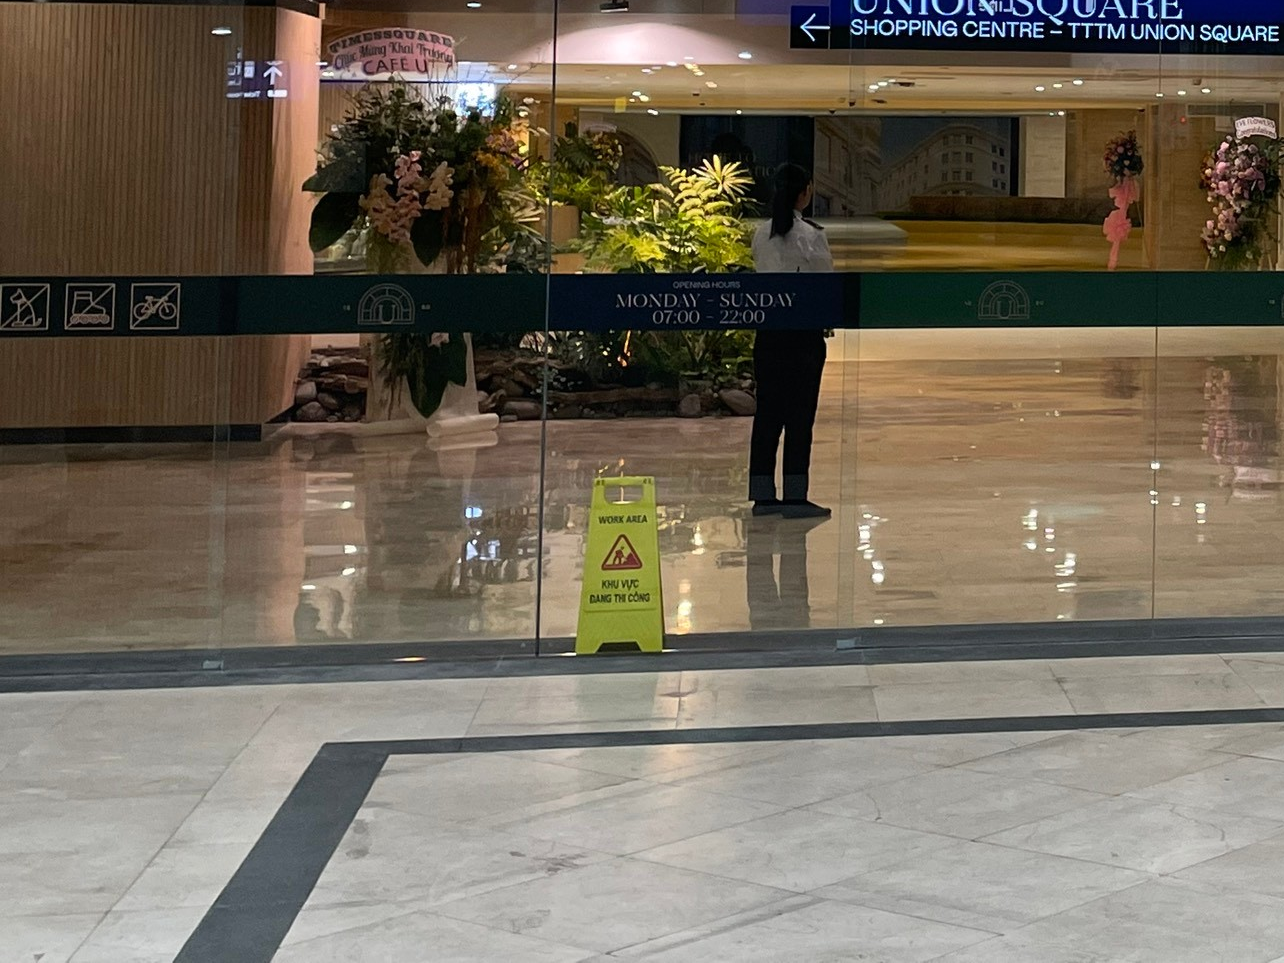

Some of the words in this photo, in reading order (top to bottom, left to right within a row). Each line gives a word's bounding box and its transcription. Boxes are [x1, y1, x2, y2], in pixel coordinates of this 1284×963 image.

[850, 18, 957, 37] SHOPPING
[963, 20, 1045, 38] CENTRE
[1067, 22, 1125, 39] TTTM
[1131, 24, 1194, 41] UNION
[1200, 25, 1279, 43] SQUARE
[672, 280, 711, 289] OPENING
[711, 280, 741, 289] HOURS
[615, 293, 701, 308] MONDAY
[719, 292, 797, 308] SUNDAY
[652, 309, 700, 325] 07:00
[719, 309, 766, 325] 22:00
[599, 515, 624, 524] WORK
[626, 515, 647, 523] AREA
[602, 580, 619, 589] KHU
[614, 594, 625, 603] THI
